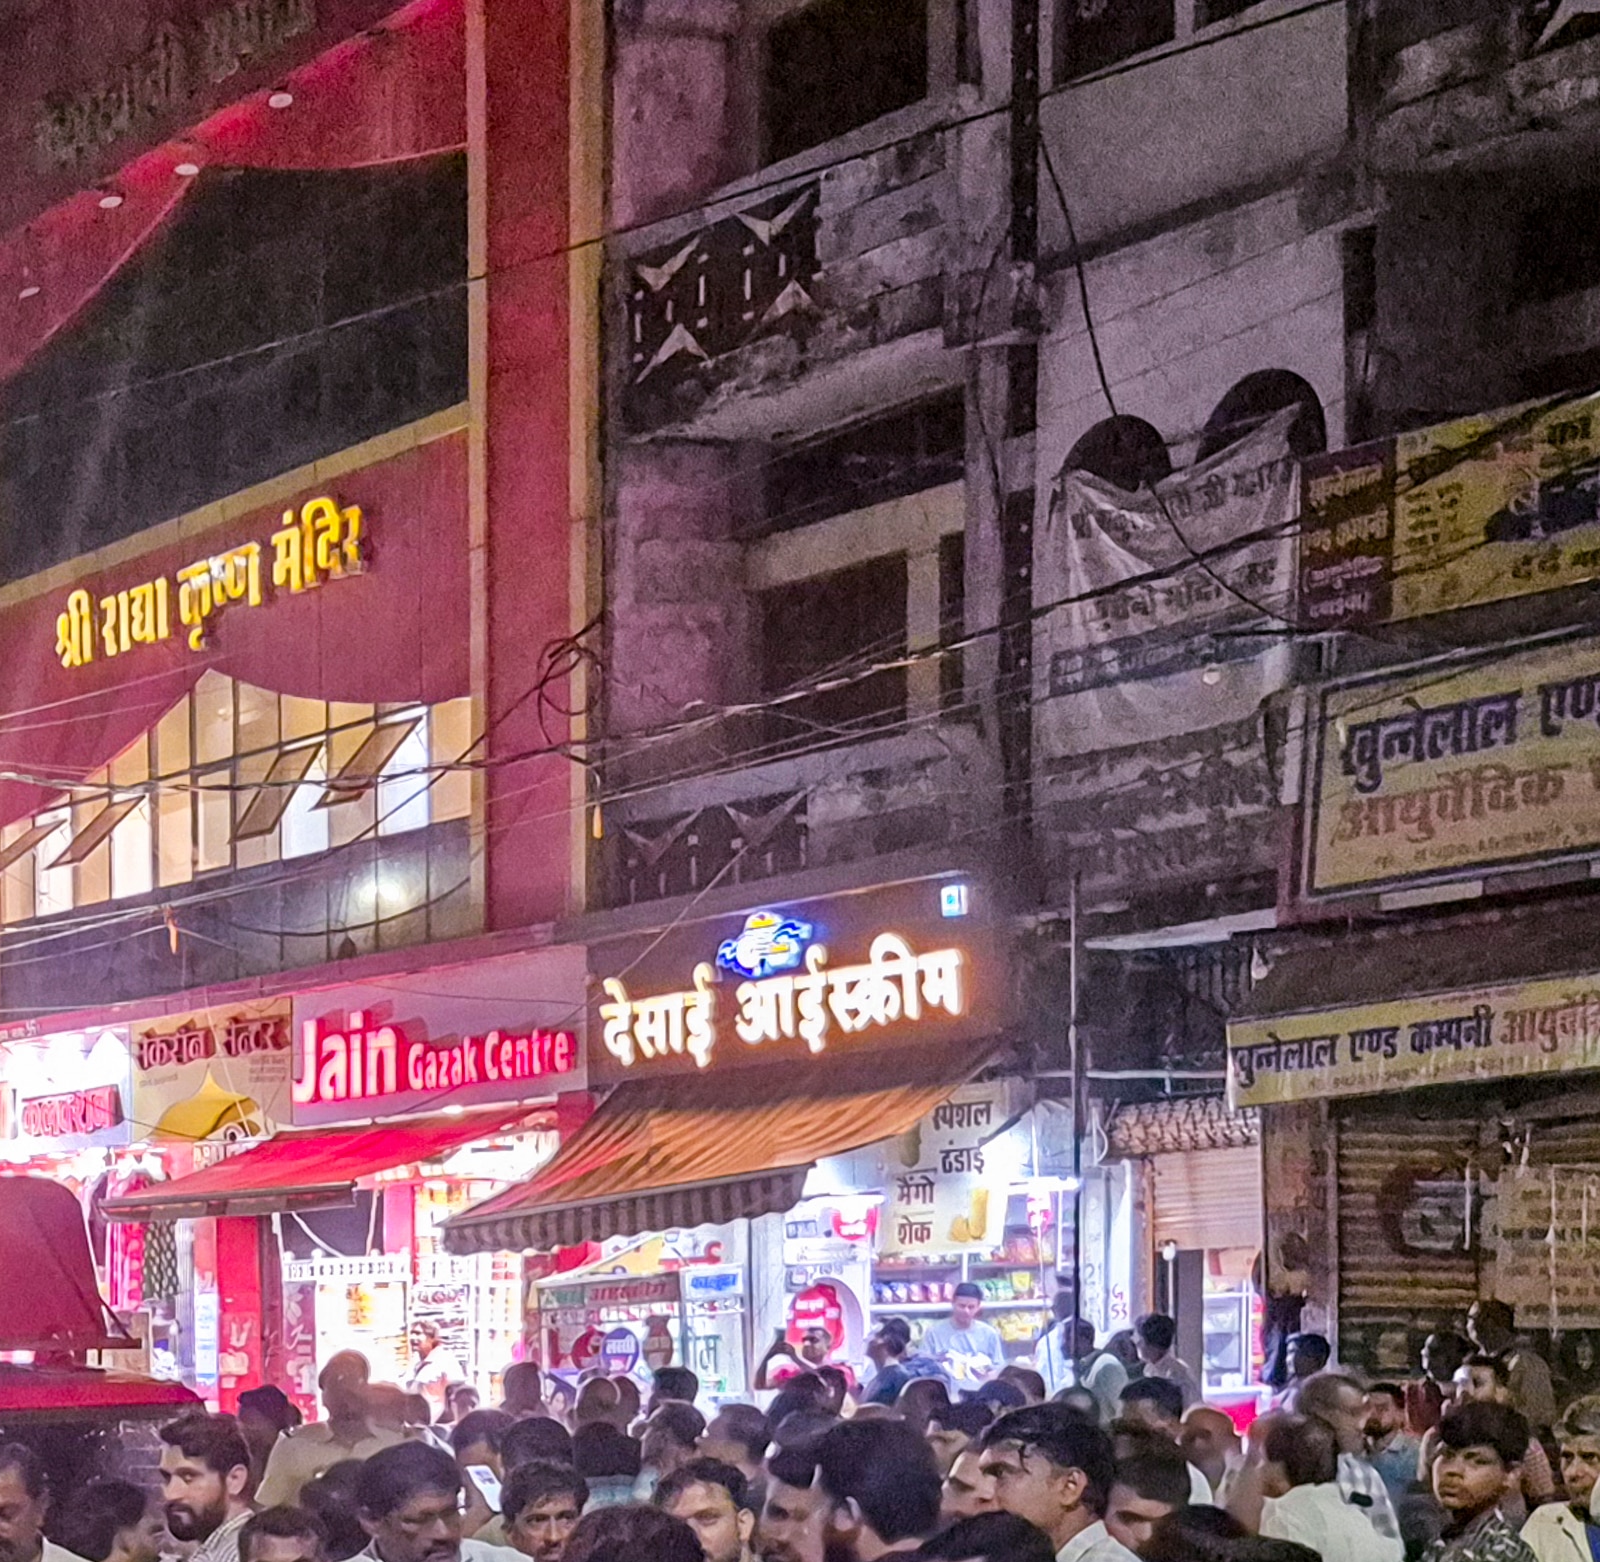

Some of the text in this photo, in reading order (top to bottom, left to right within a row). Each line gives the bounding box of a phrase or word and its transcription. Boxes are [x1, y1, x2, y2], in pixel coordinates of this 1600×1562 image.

[55, 588, 93, 668] श्री
[176, 541, 262, 651] कृष्ण
[271, 496, 364, 593] मंदिर
[599, 931, 965, 1067] देसाई आईस्क्रीम
[1408, 1004, 1497, 1054] कम्पनी
[292, 1010, 398, 1103] Jain
[407, 1034, 479, 1091] Gazak
[484, 1028, 571, 1081] Centre
[932, 1099, 994, 1131] स्पेशल
[896, 1174, 937, 1205] मैंगो
[898, 1215, 933, 1245] शेक
